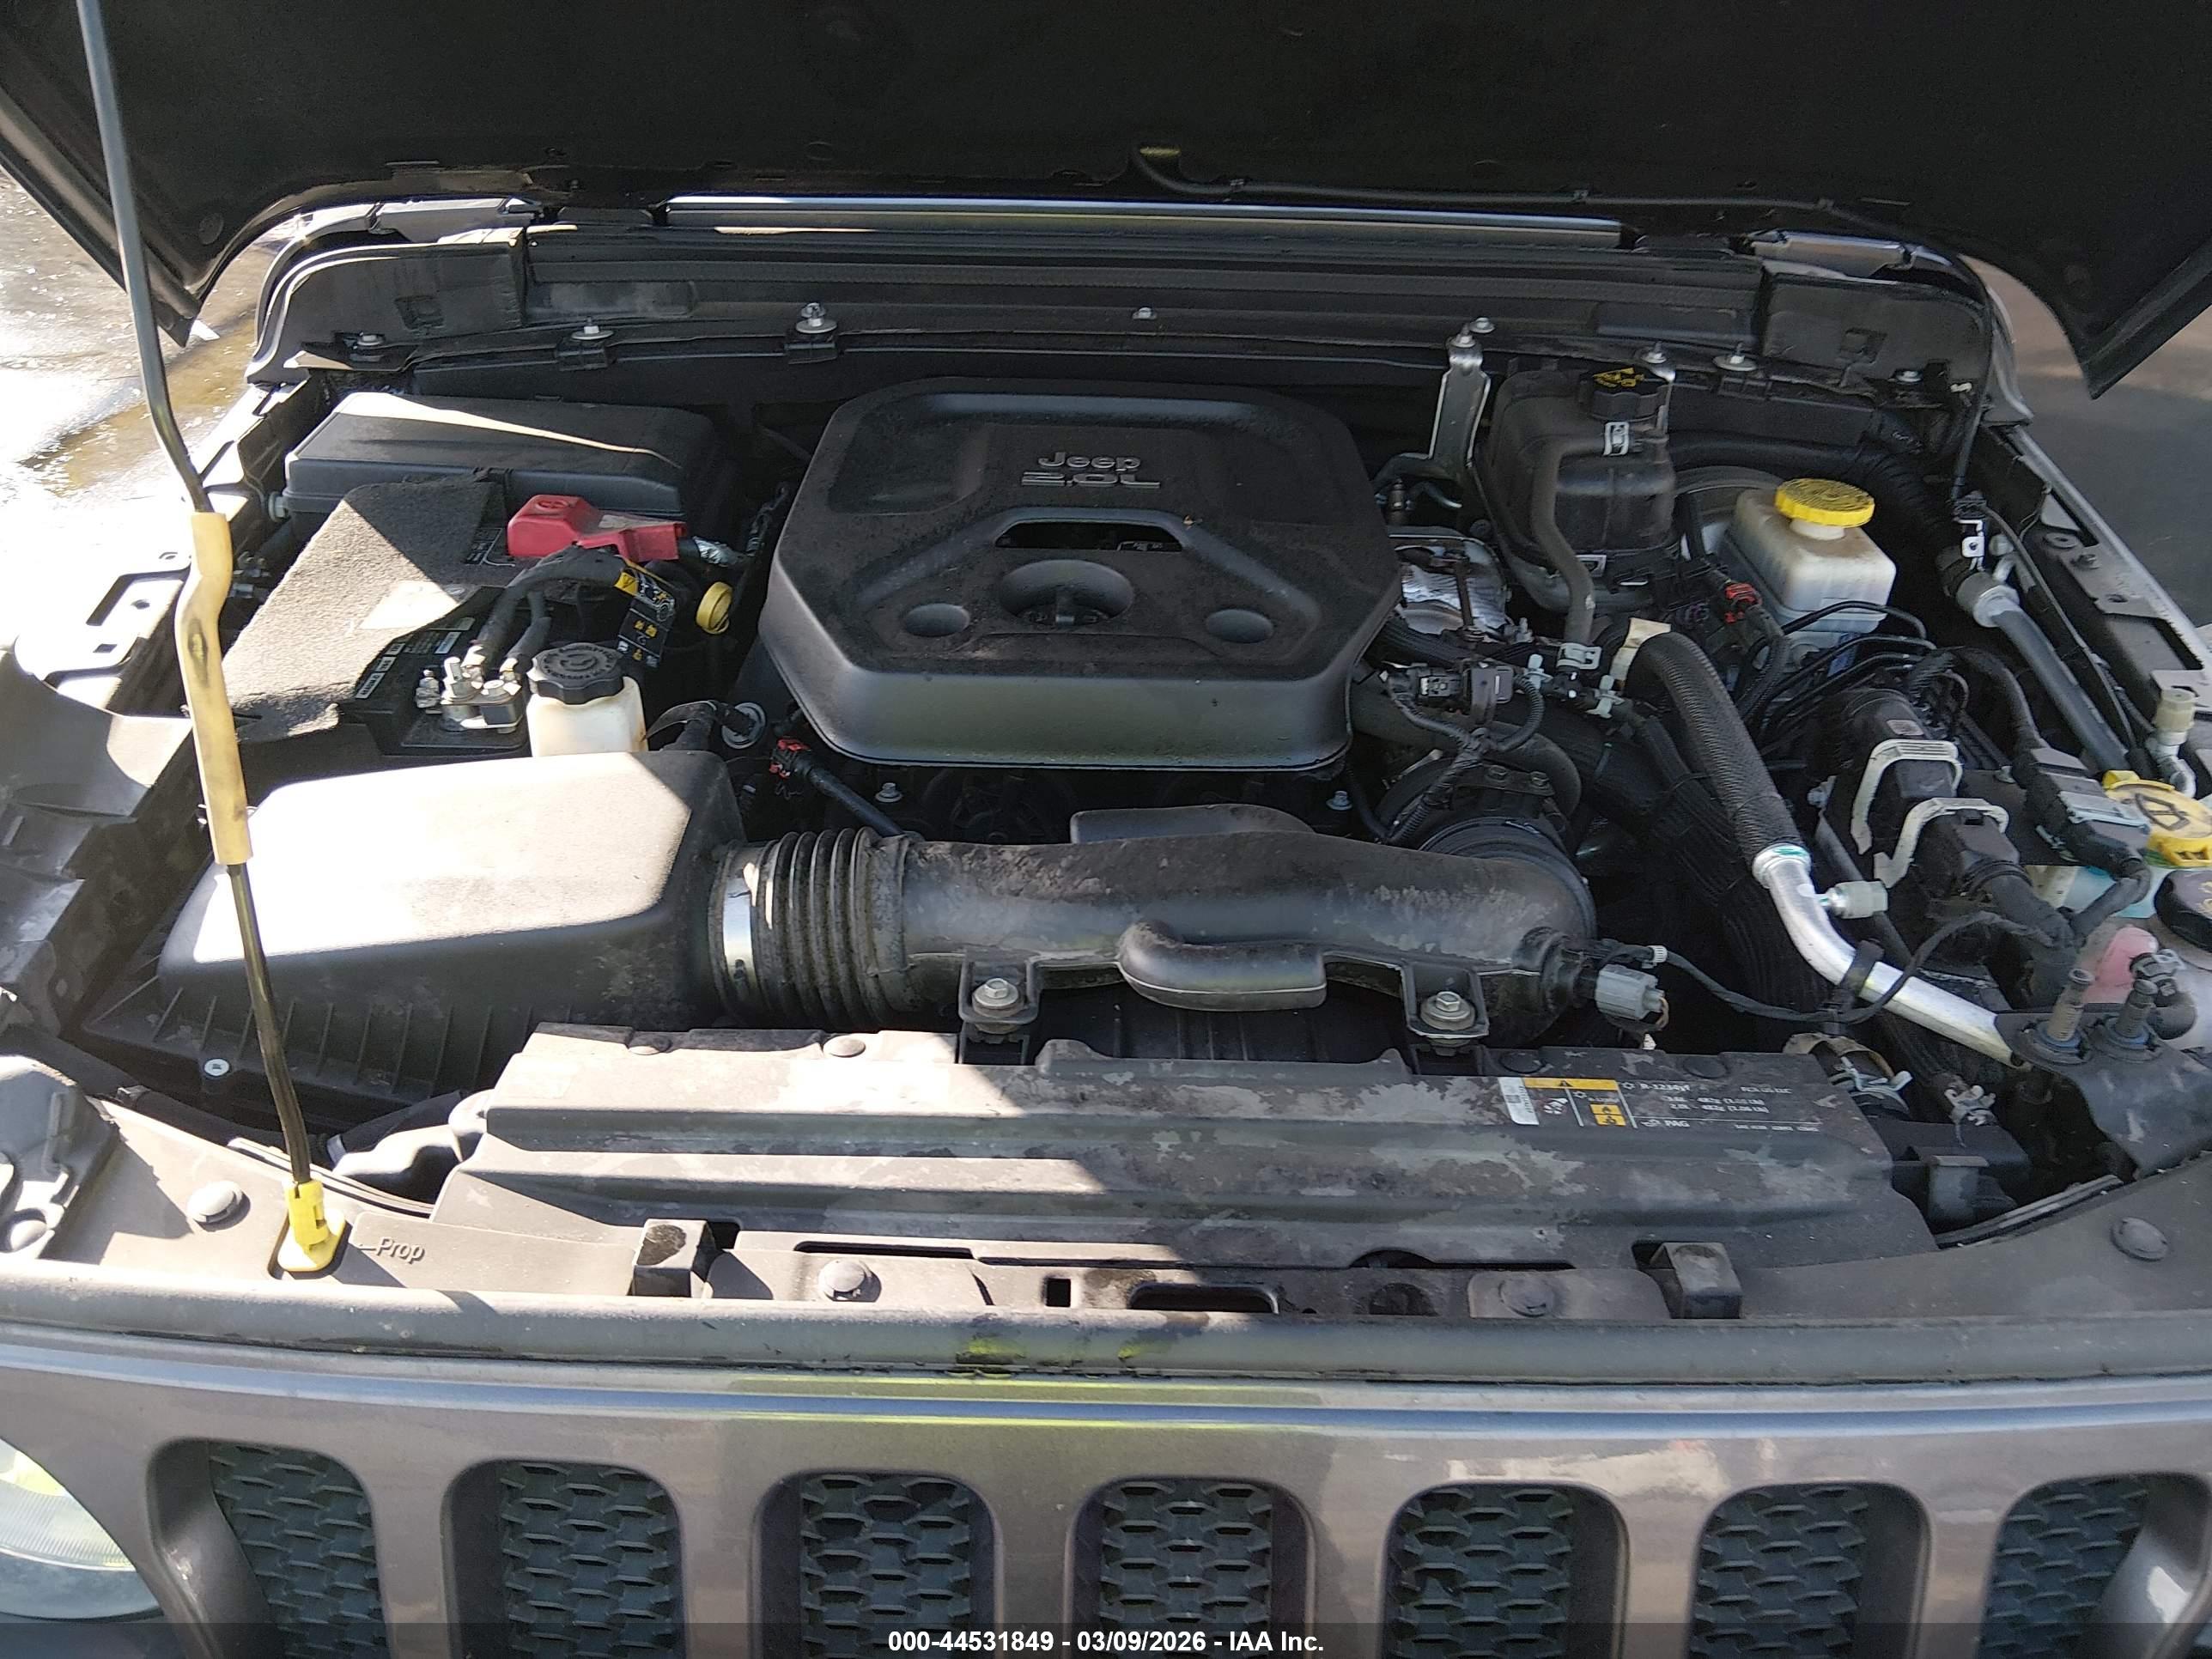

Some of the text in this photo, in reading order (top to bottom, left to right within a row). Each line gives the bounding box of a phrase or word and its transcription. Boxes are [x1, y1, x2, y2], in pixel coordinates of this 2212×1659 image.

[1038, 452, 1141, 471] Jeep
[1021, 471, 1160, 489] 2.0L
[375, 1237, 425, 1265] Prop
